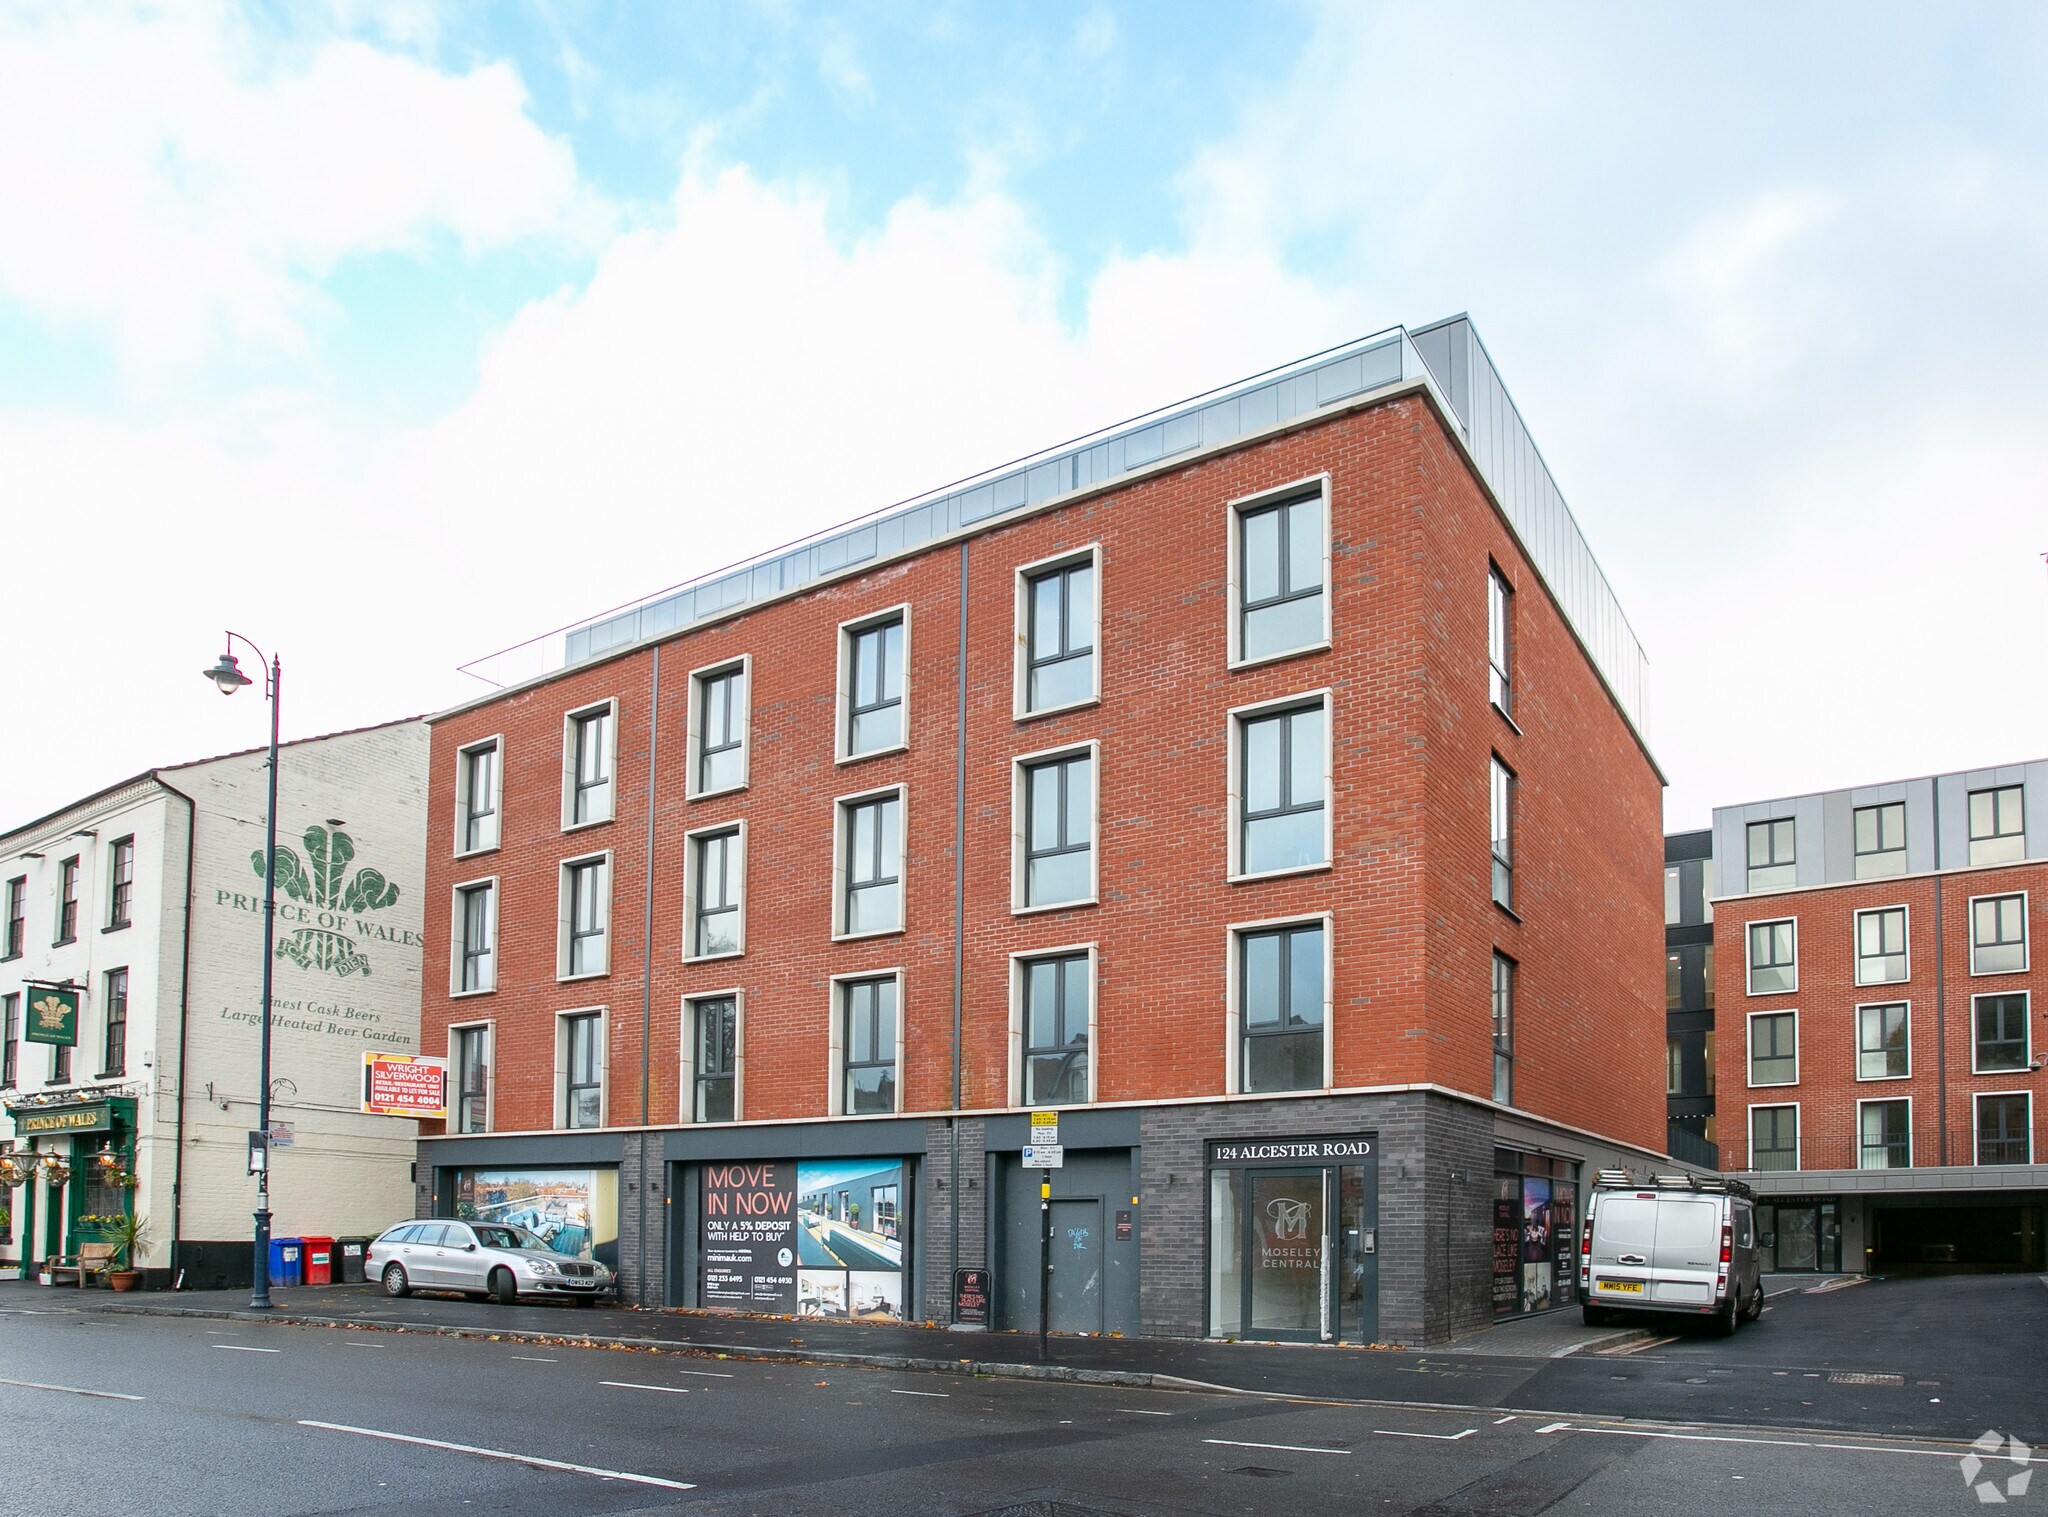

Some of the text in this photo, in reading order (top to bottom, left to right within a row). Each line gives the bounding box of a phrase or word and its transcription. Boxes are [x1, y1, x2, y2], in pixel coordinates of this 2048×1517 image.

[317, 912, 349, 931] OF
[355, 919, 424, 948] WALES
[282, 939, 309, 967] ICH
[339, 953, 368, 975] DIEN
[259, 995, 381, 1023] nest Cask Beers
[270, 1014, 323, 1032] Heated
[327, 1022, 359, 1037] Beer
[362, 1027, 411, 1044] Garden
[387, 1063, 430, 1075] WRIGHT
[375, 1070, 441, 1083] SILVERWOOD
[374, 1092, 440, 1105] 0121 454 4004
[26, 1112, 97, 1131] PRINCE OF WALES
[1025, 1148, 1032, 1157] P
[1216, 1142, 1370, 1160] 124 ALCESTER ROAD
[708, 1164, 775, 1188] MOVE
[707, 1191, 793, 1215] IN NOW
[707, 1220, 792, 1231] ONLY A 5% DEPOSIT
[707, 1231, 728, 1241] WITH
[729, 1231, 750, 1241] HELP
[752, 1232, 764, 1241] TO
[707, 1253, 752, 1262] minimauk.com
[1261, 1247, 1321, 1257] MOSELEY
[1263, 1259, 1320, 1269] CENTRAL
[707, 1274, 718, 1282] 0121
[1603, 1281, 1638, 1291] MM15 YFE
